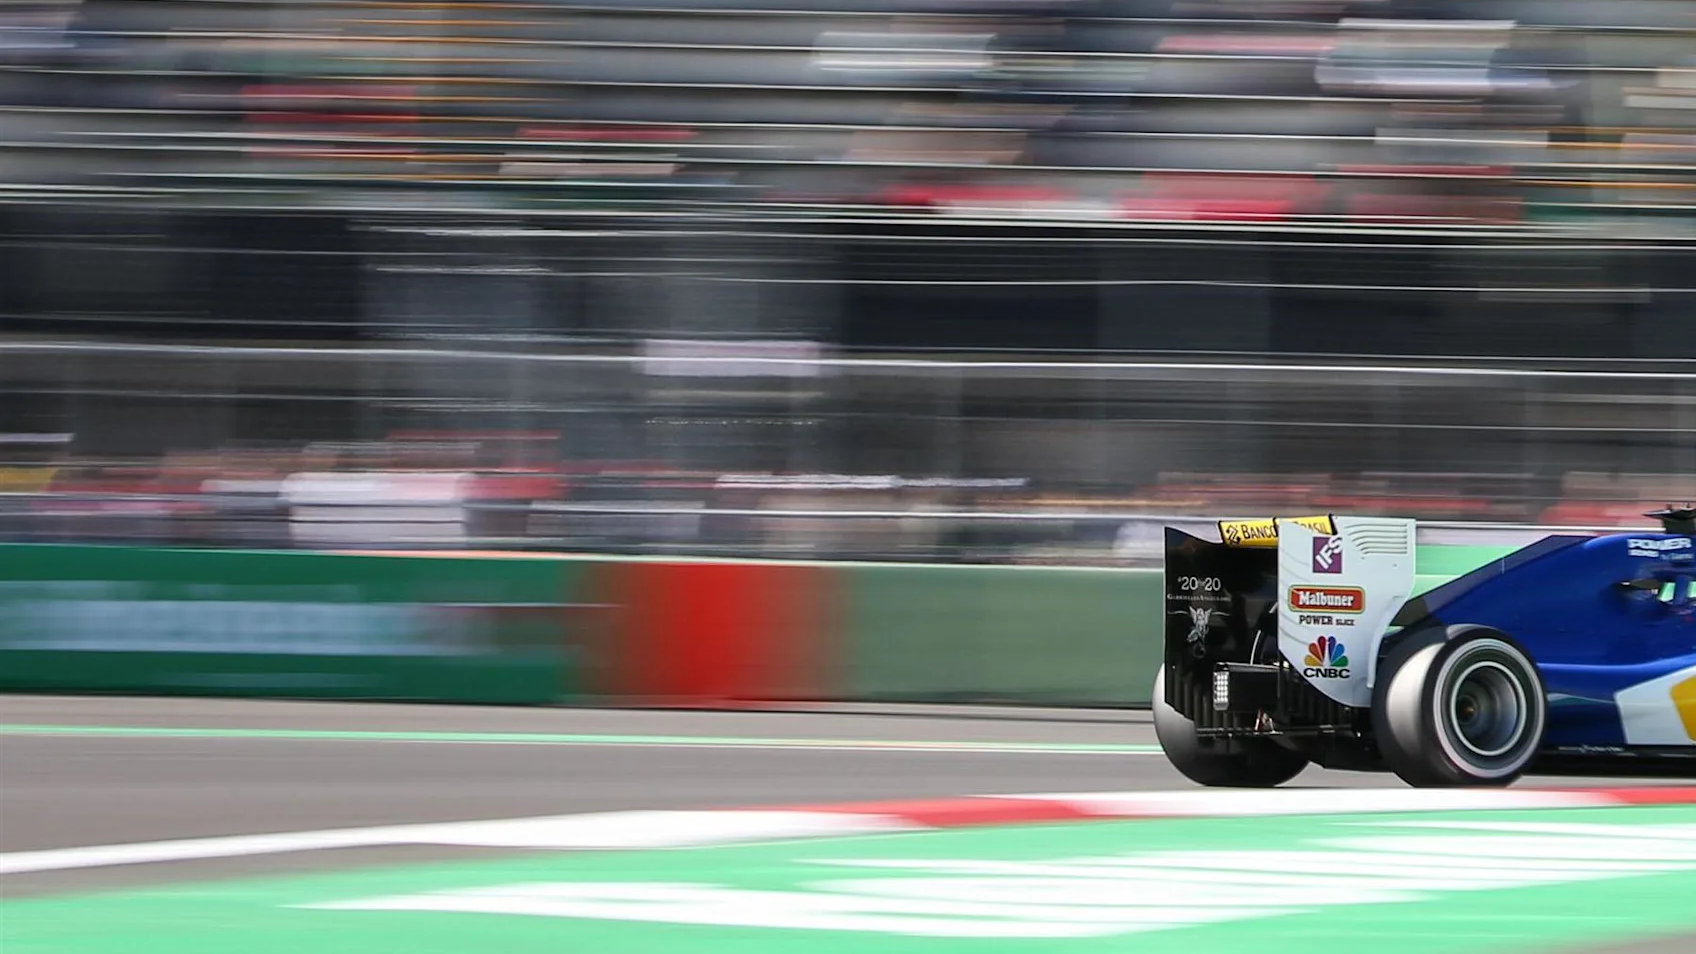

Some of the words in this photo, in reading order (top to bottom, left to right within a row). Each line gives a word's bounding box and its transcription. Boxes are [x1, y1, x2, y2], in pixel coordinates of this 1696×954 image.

[1315, 535, 1343, 570] IFS
[1298, 590, 1355, 607] Malbuner
[1299, 614, 1334, 626] POWER
[1303, 667, 1351, 679] CNBC
